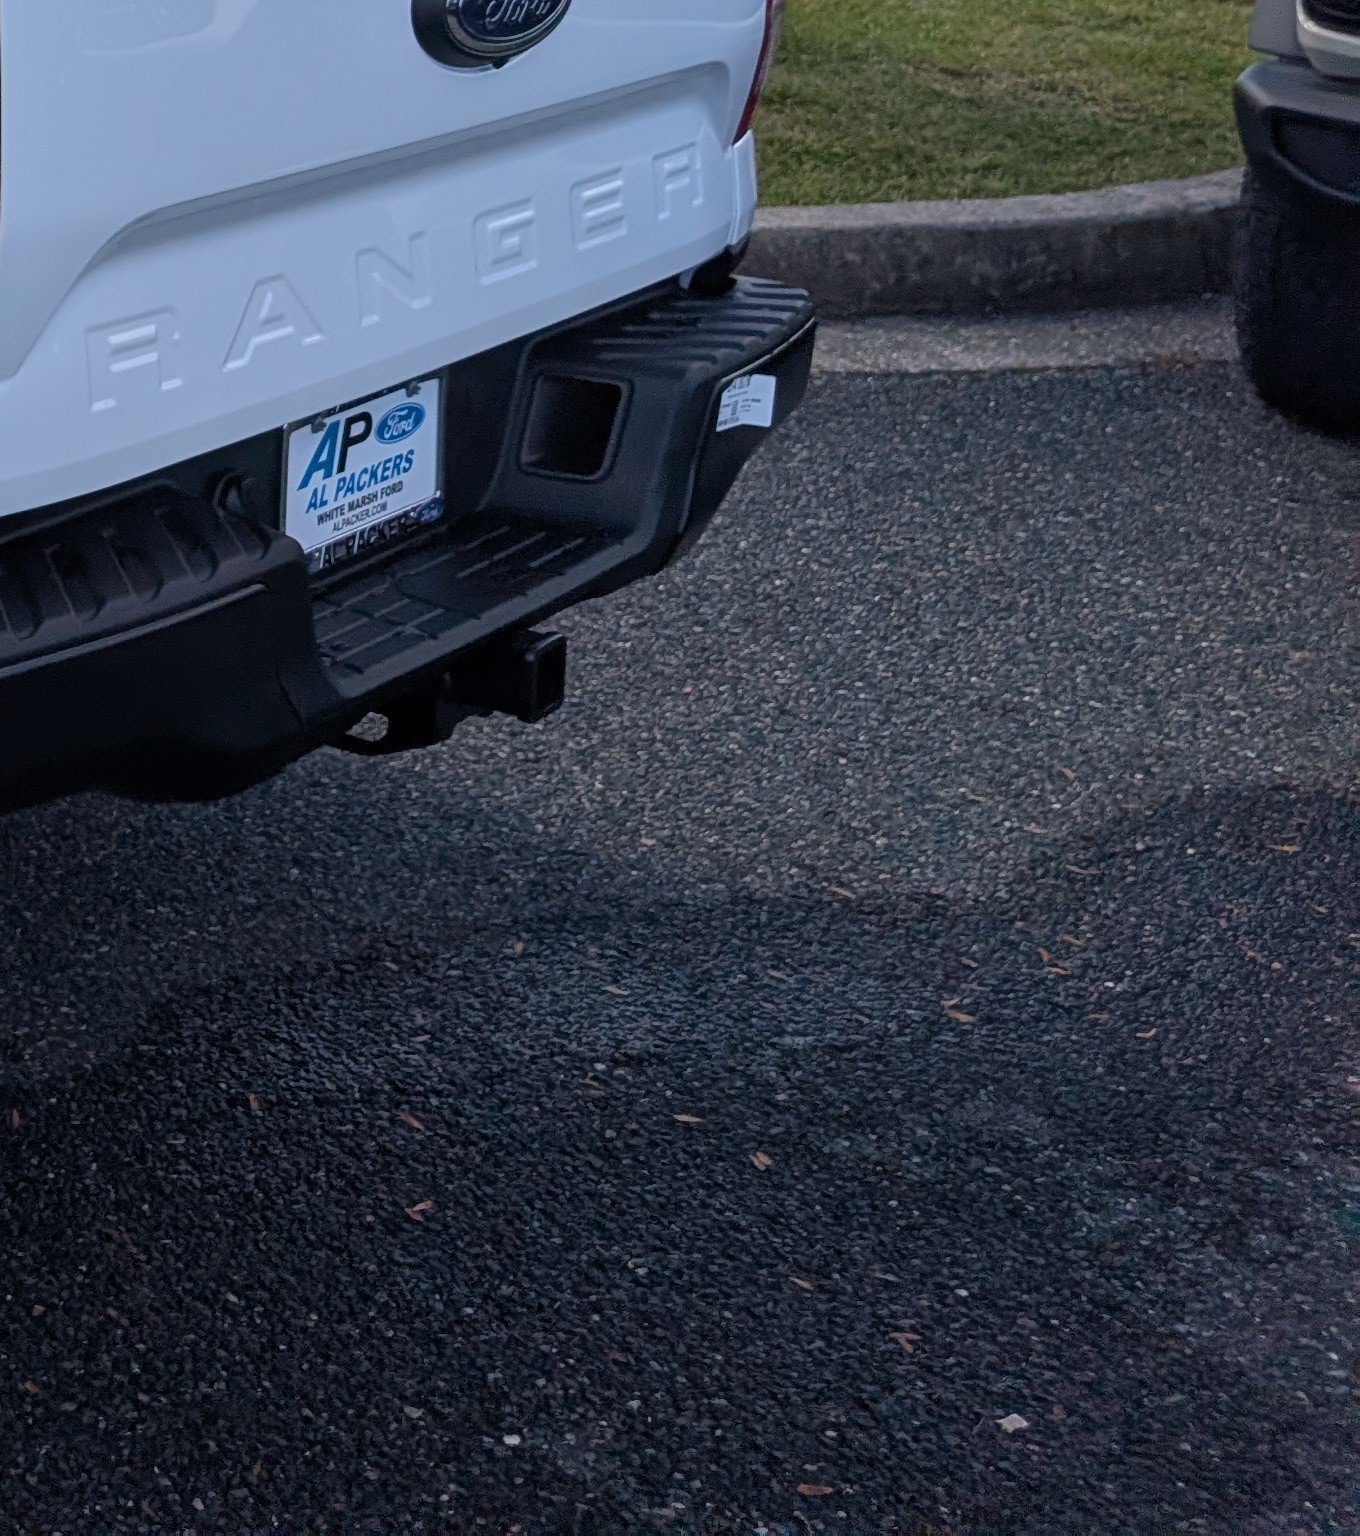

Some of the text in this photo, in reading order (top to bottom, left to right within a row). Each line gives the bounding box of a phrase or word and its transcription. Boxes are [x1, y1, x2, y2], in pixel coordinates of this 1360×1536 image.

[84, 140, 704, 412] RANGER
[383, 409, 416, 439] Ford
[305, 449, 414, 514] AL PACKERS
[317, 480, 403, 525] WHITE MARSH FORD
